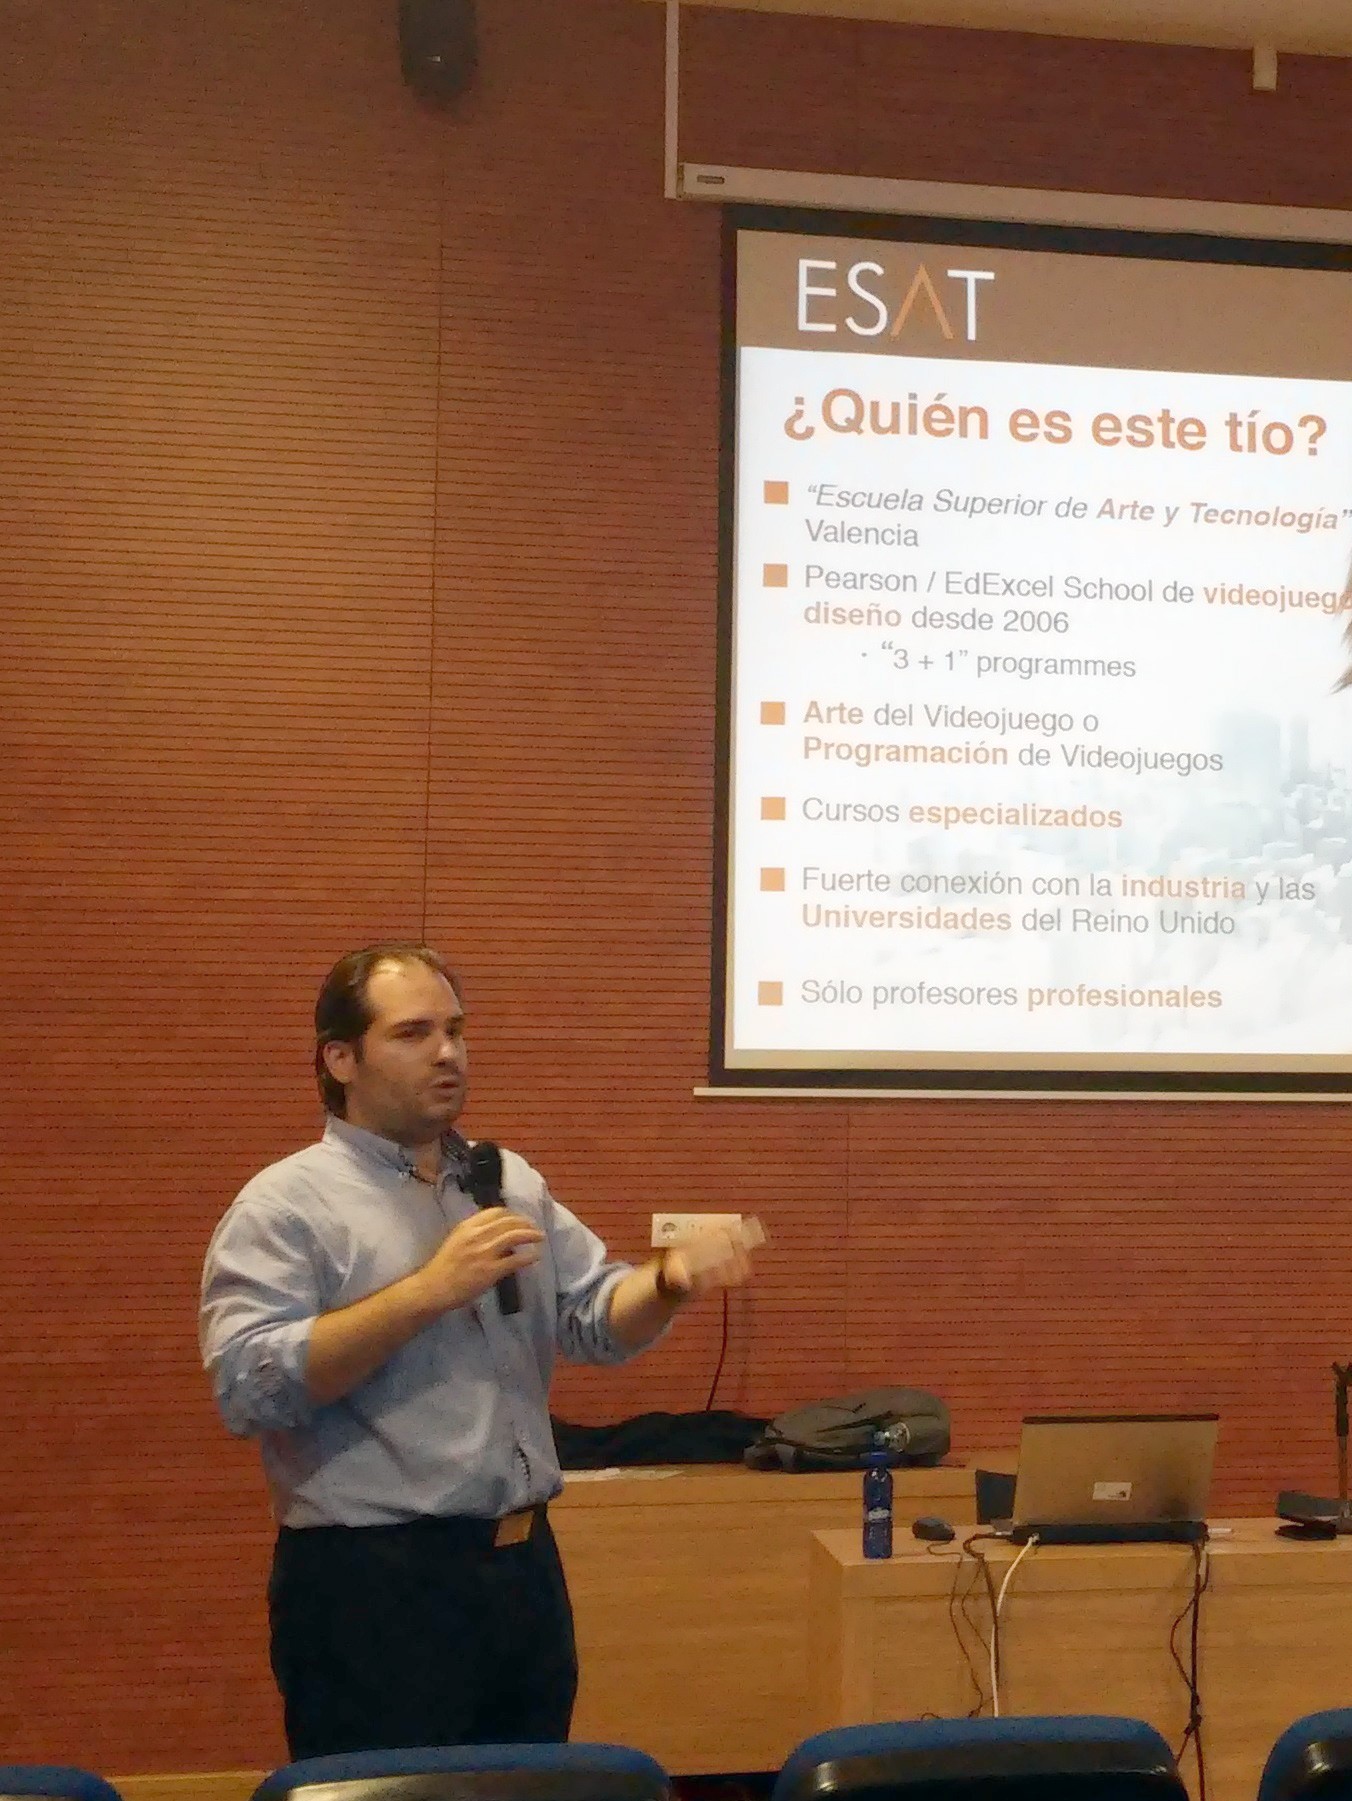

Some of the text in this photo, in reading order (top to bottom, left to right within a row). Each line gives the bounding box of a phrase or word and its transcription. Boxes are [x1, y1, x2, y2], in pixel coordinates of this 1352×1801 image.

[798, 258, 994, 340] ESAT
[783, 387, 1328, 456] ¿Quién es este tío?
[932, 488, 1048, 521] Superior
[1054, 497, 1089, 520] de
[1096, 499, 1154, 523] Arte
[1162, 504, 1178, 526] y
[805, 519, 919, 548] Valencia
[805, 564, 918, 595] Pearson
[945, 572, 1055, 598] EdExcel
[1063, 575, 1155, 603] School
[1162, 580, 1195, 604] de
[803, 603, 1070, 634] diseño desde 2006
[918, 652, 934, 671] +
[977, 653, 1138, 678] programmes
[803, 701, 1099, 737] Arte del Videojuego o
[803, 738, 1224, 775] Programación de Videojuegos
[802, 797, 1123, 831] Cursos especializados
[802, 868, 1316, 905] Fuerte conexión con la industria y las
[802, 905, 1236, 935] Universidades del Reino Unido
[801, 980, 1223, 1011] Sólo profesores profesionales
